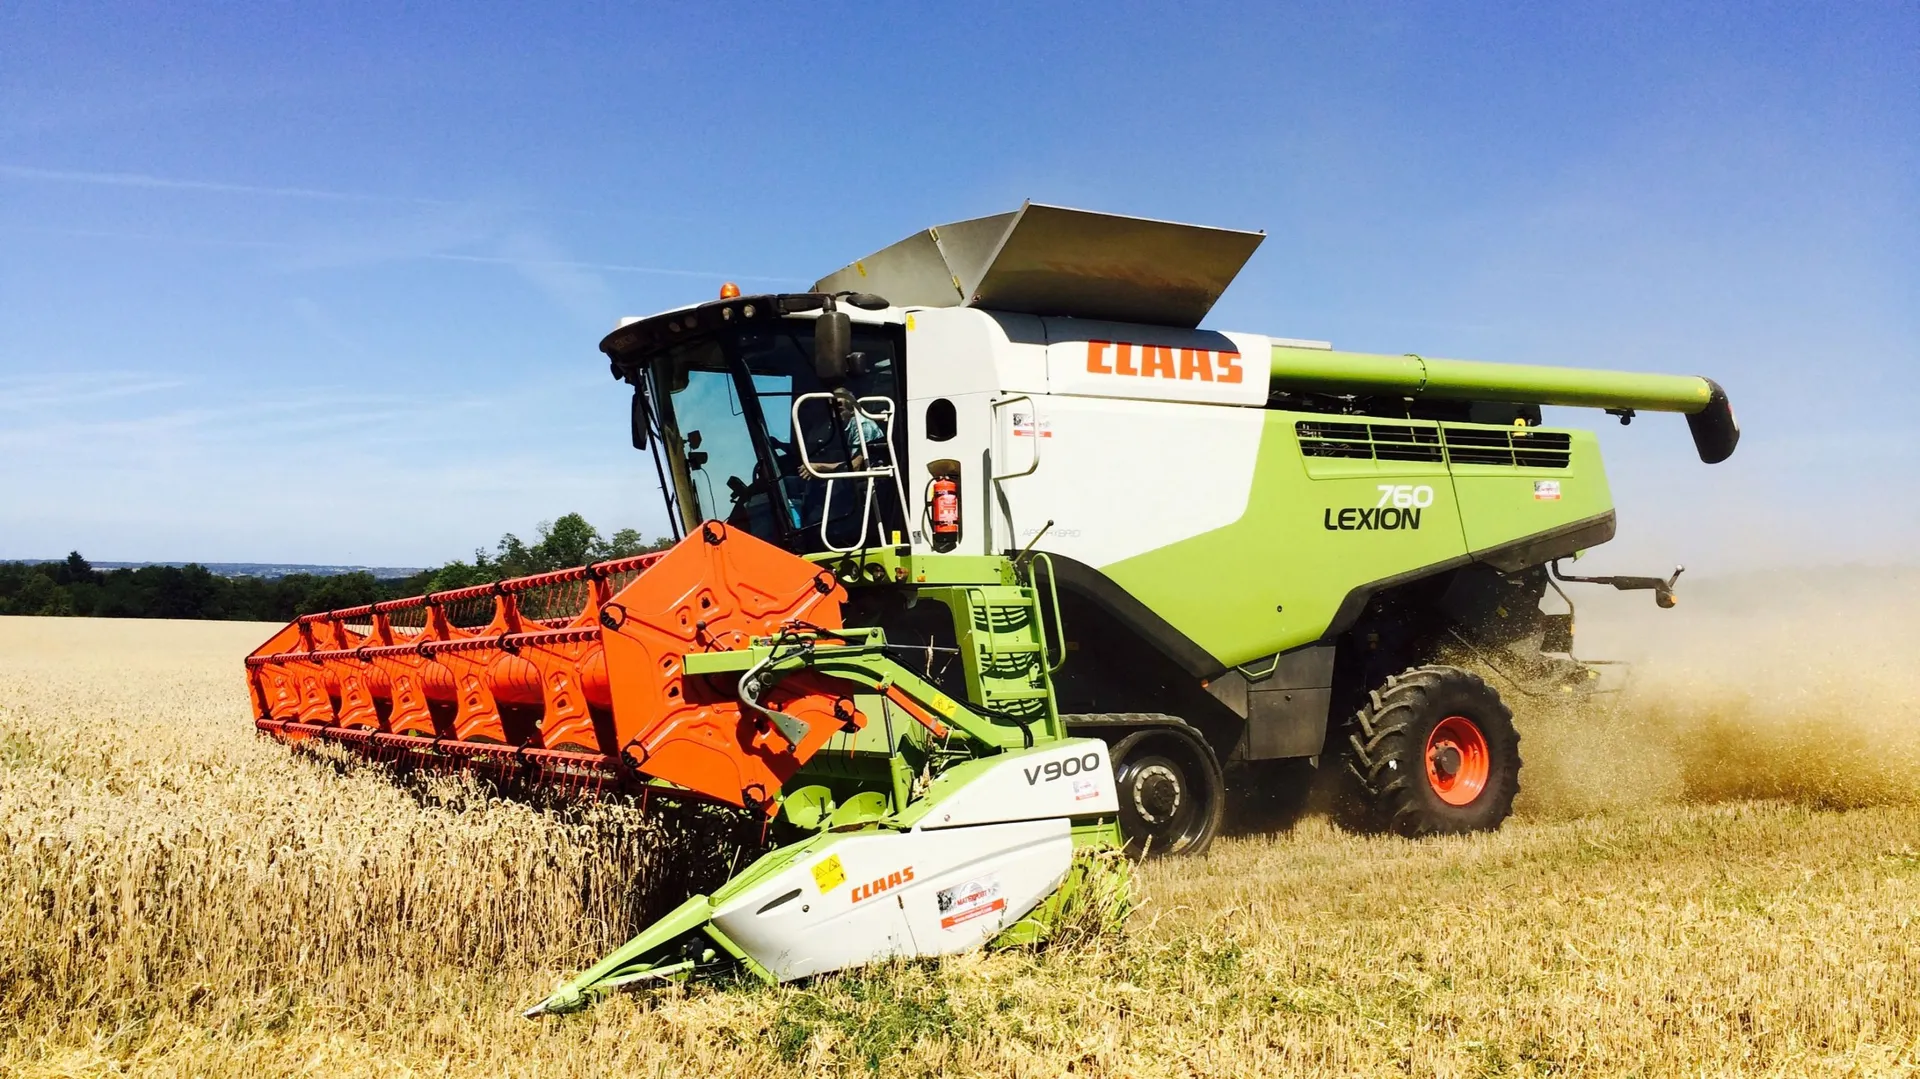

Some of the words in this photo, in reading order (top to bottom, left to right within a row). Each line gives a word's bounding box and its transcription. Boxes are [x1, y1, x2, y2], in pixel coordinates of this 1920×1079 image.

[1087, 339, 1243, 384] CLAAS
[1376, 485, 1434, 508] 760
[1324, 508, 1421, 530] LEXION
[1023, 753, 1100, 786] V900
[851, 866, 914, 903] CLAAS
